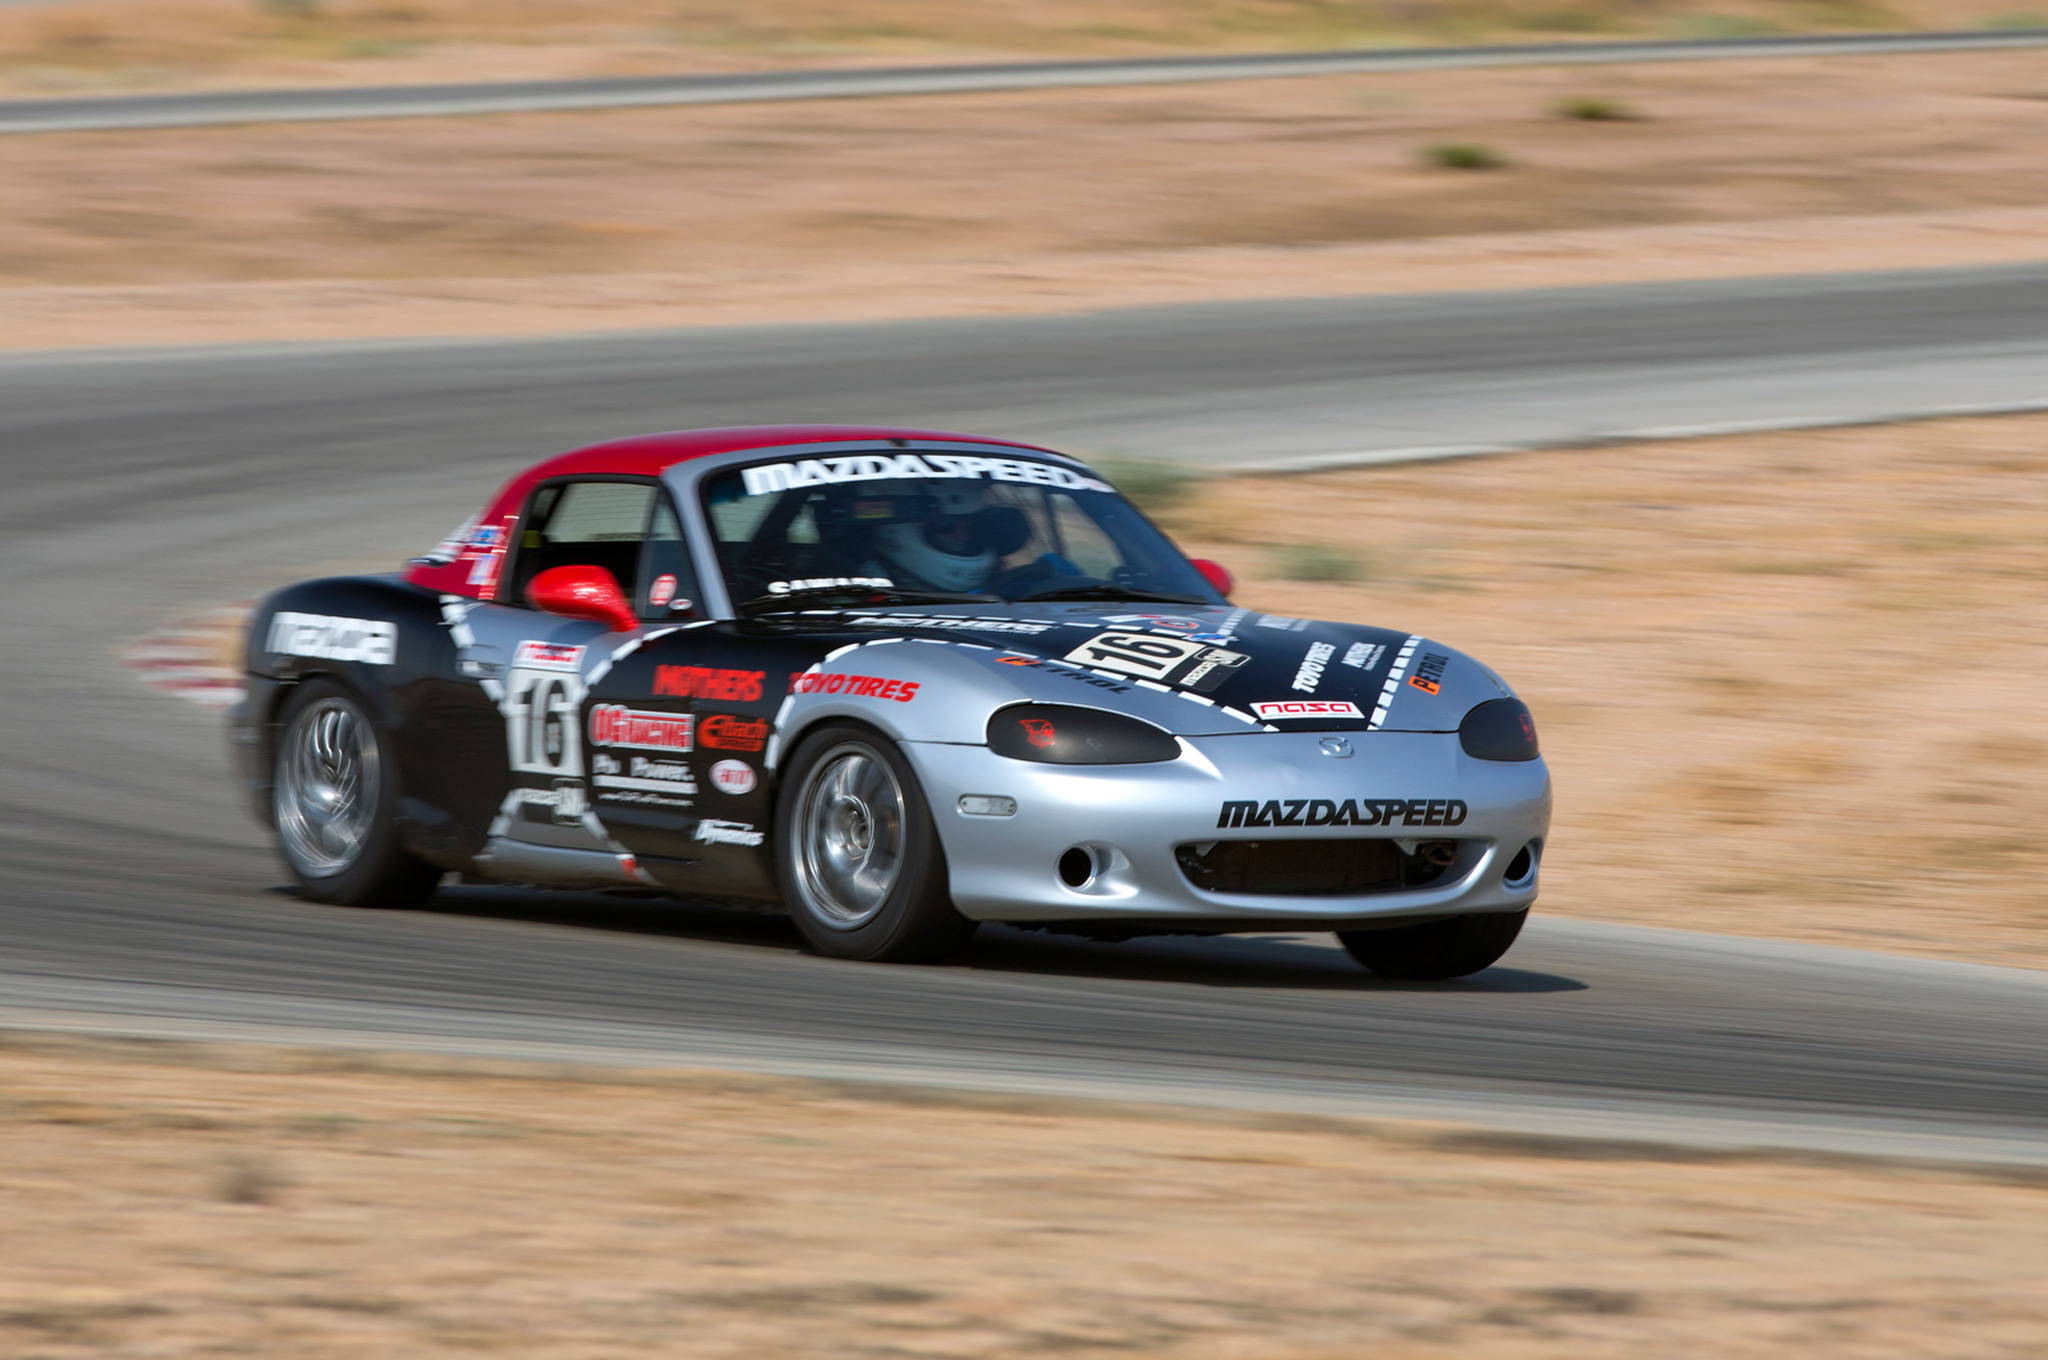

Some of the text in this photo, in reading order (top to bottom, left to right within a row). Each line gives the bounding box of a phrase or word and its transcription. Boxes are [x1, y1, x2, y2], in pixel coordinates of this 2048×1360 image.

[741, 454, 1087, 496] MAZDASPEED
[1086, 635, 1185, 671] 16
[652, 665, 767, 702] MOTHERS
[1413, 652, 1449, 693] PETROL
[511, 678, 575, 769] 16
[697, 715, 769, 749] Eibach
[1217, 799, 1468, 828] MAZDASPEED
